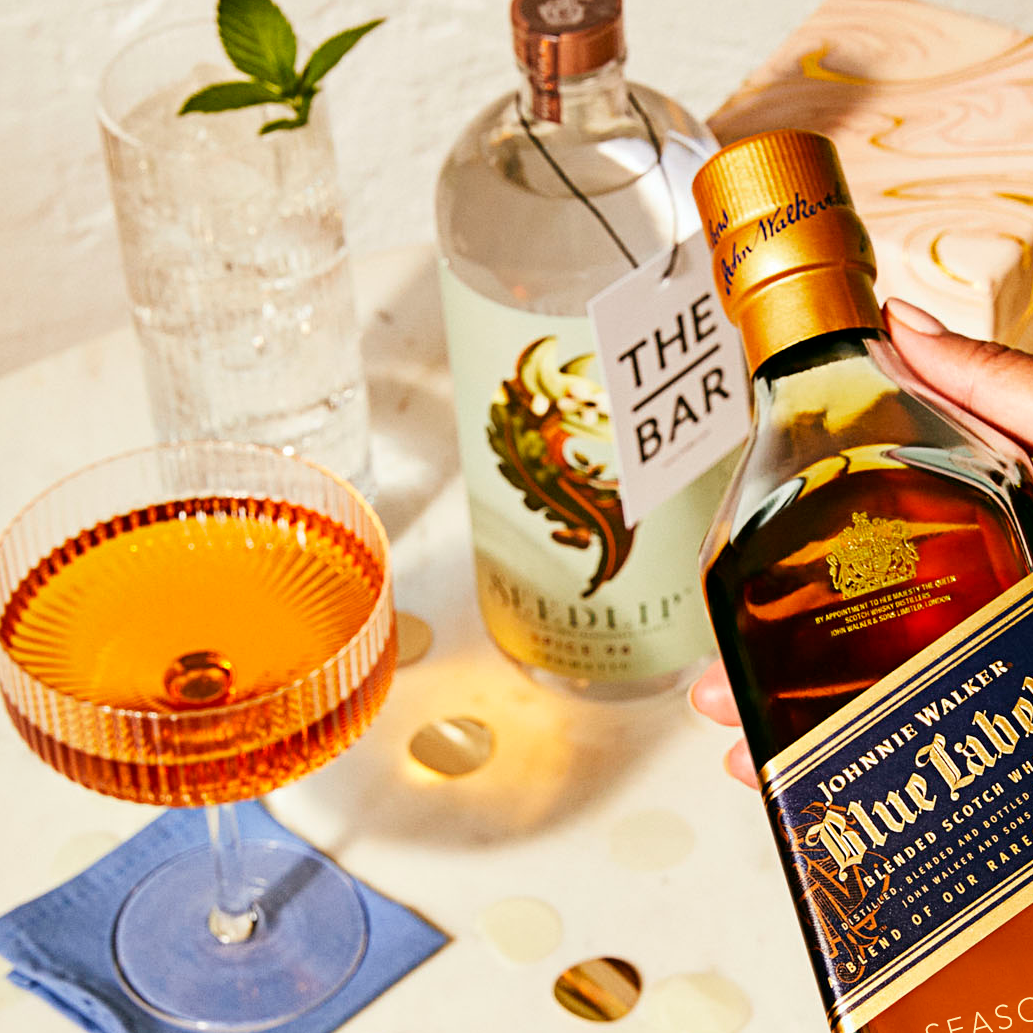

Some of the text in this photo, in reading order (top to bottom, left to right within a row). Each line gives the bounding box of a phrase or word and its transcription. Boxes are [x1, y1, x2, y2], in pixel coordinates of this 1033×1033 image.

[617, 292, 718, 388] THE
[635, 367, 730, 464] BAR
[815, 615, 825, 625] BY
[825, 602, 869, 622] APPOINTMENT
[870, 599, 880, 608] TO
[844, 609, 871, 625] SCOTCH
[870, 602, 895, 616] WHISKY
[816, 660, 1010, 807] JOHNNIE WALKER
[805, 772, 937, 882] Blue
[862, 831, 938, 889] BLENDED
[941, 782, 1005, 833] SCOTCH
[901, 884, 931, 909] JOHN
[931, 851, 976, 886] WALKER
[977, 834, 1000, 854] AND
[1002, 810, 1033, 836] SONS
[905, 846, 955, 886] BLENDED
[957, 827, 980, 848] AND
[981, 791, 1031, 830] BOTTLED
[845, 928, 903, 975] BLEND
[911, 905, 934, 927] OF
[942, 872, 980, 904] OUR
